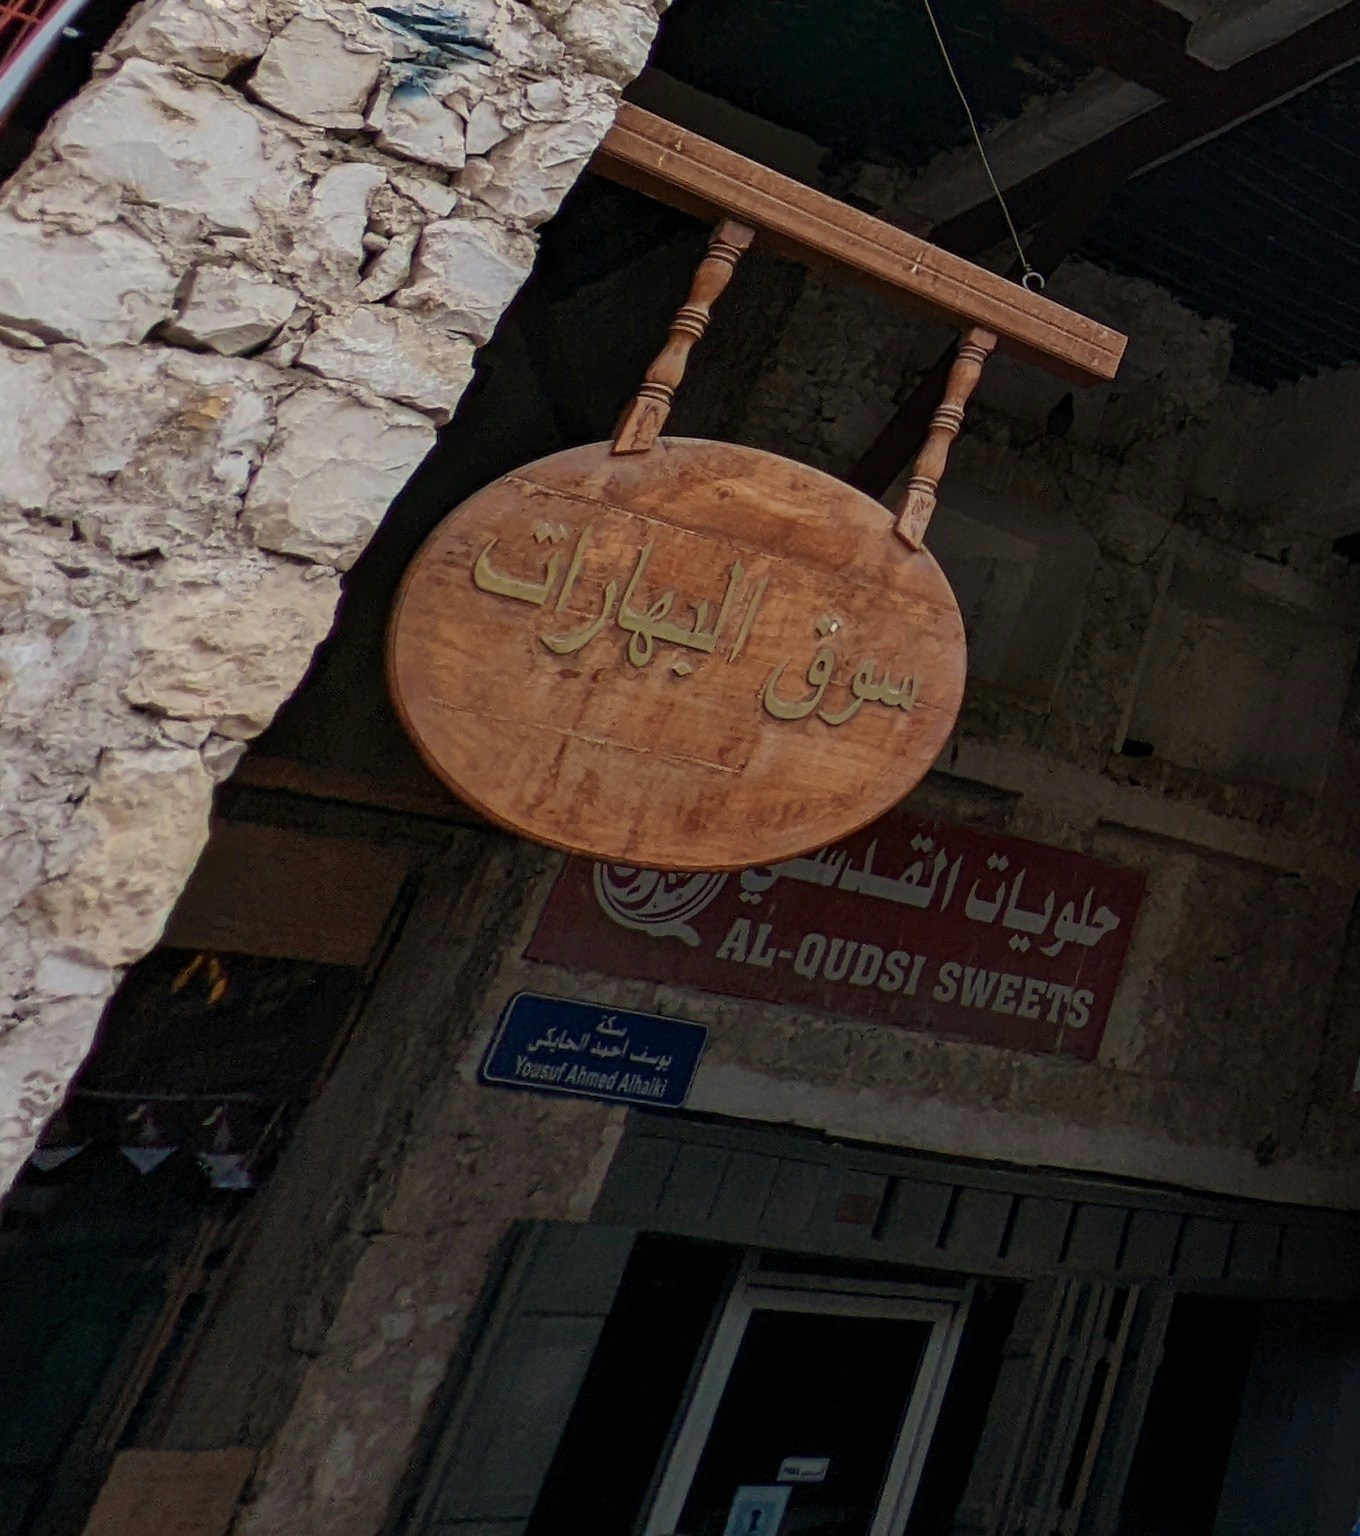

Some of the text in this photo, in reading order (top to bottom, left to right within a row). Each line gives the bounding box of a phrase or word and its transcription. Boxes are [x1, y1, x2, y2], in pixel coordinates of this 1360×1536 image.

[473, 520, 921, 725] سوق البهارات
[965, 852, 1120, 957] حلويات
[715, 918, 1094, 1028] AL-QUDSI SWEETS
[565, 1065, 620, 1091] Ahmed
[630, 1046, 672, 1071] يوسف
